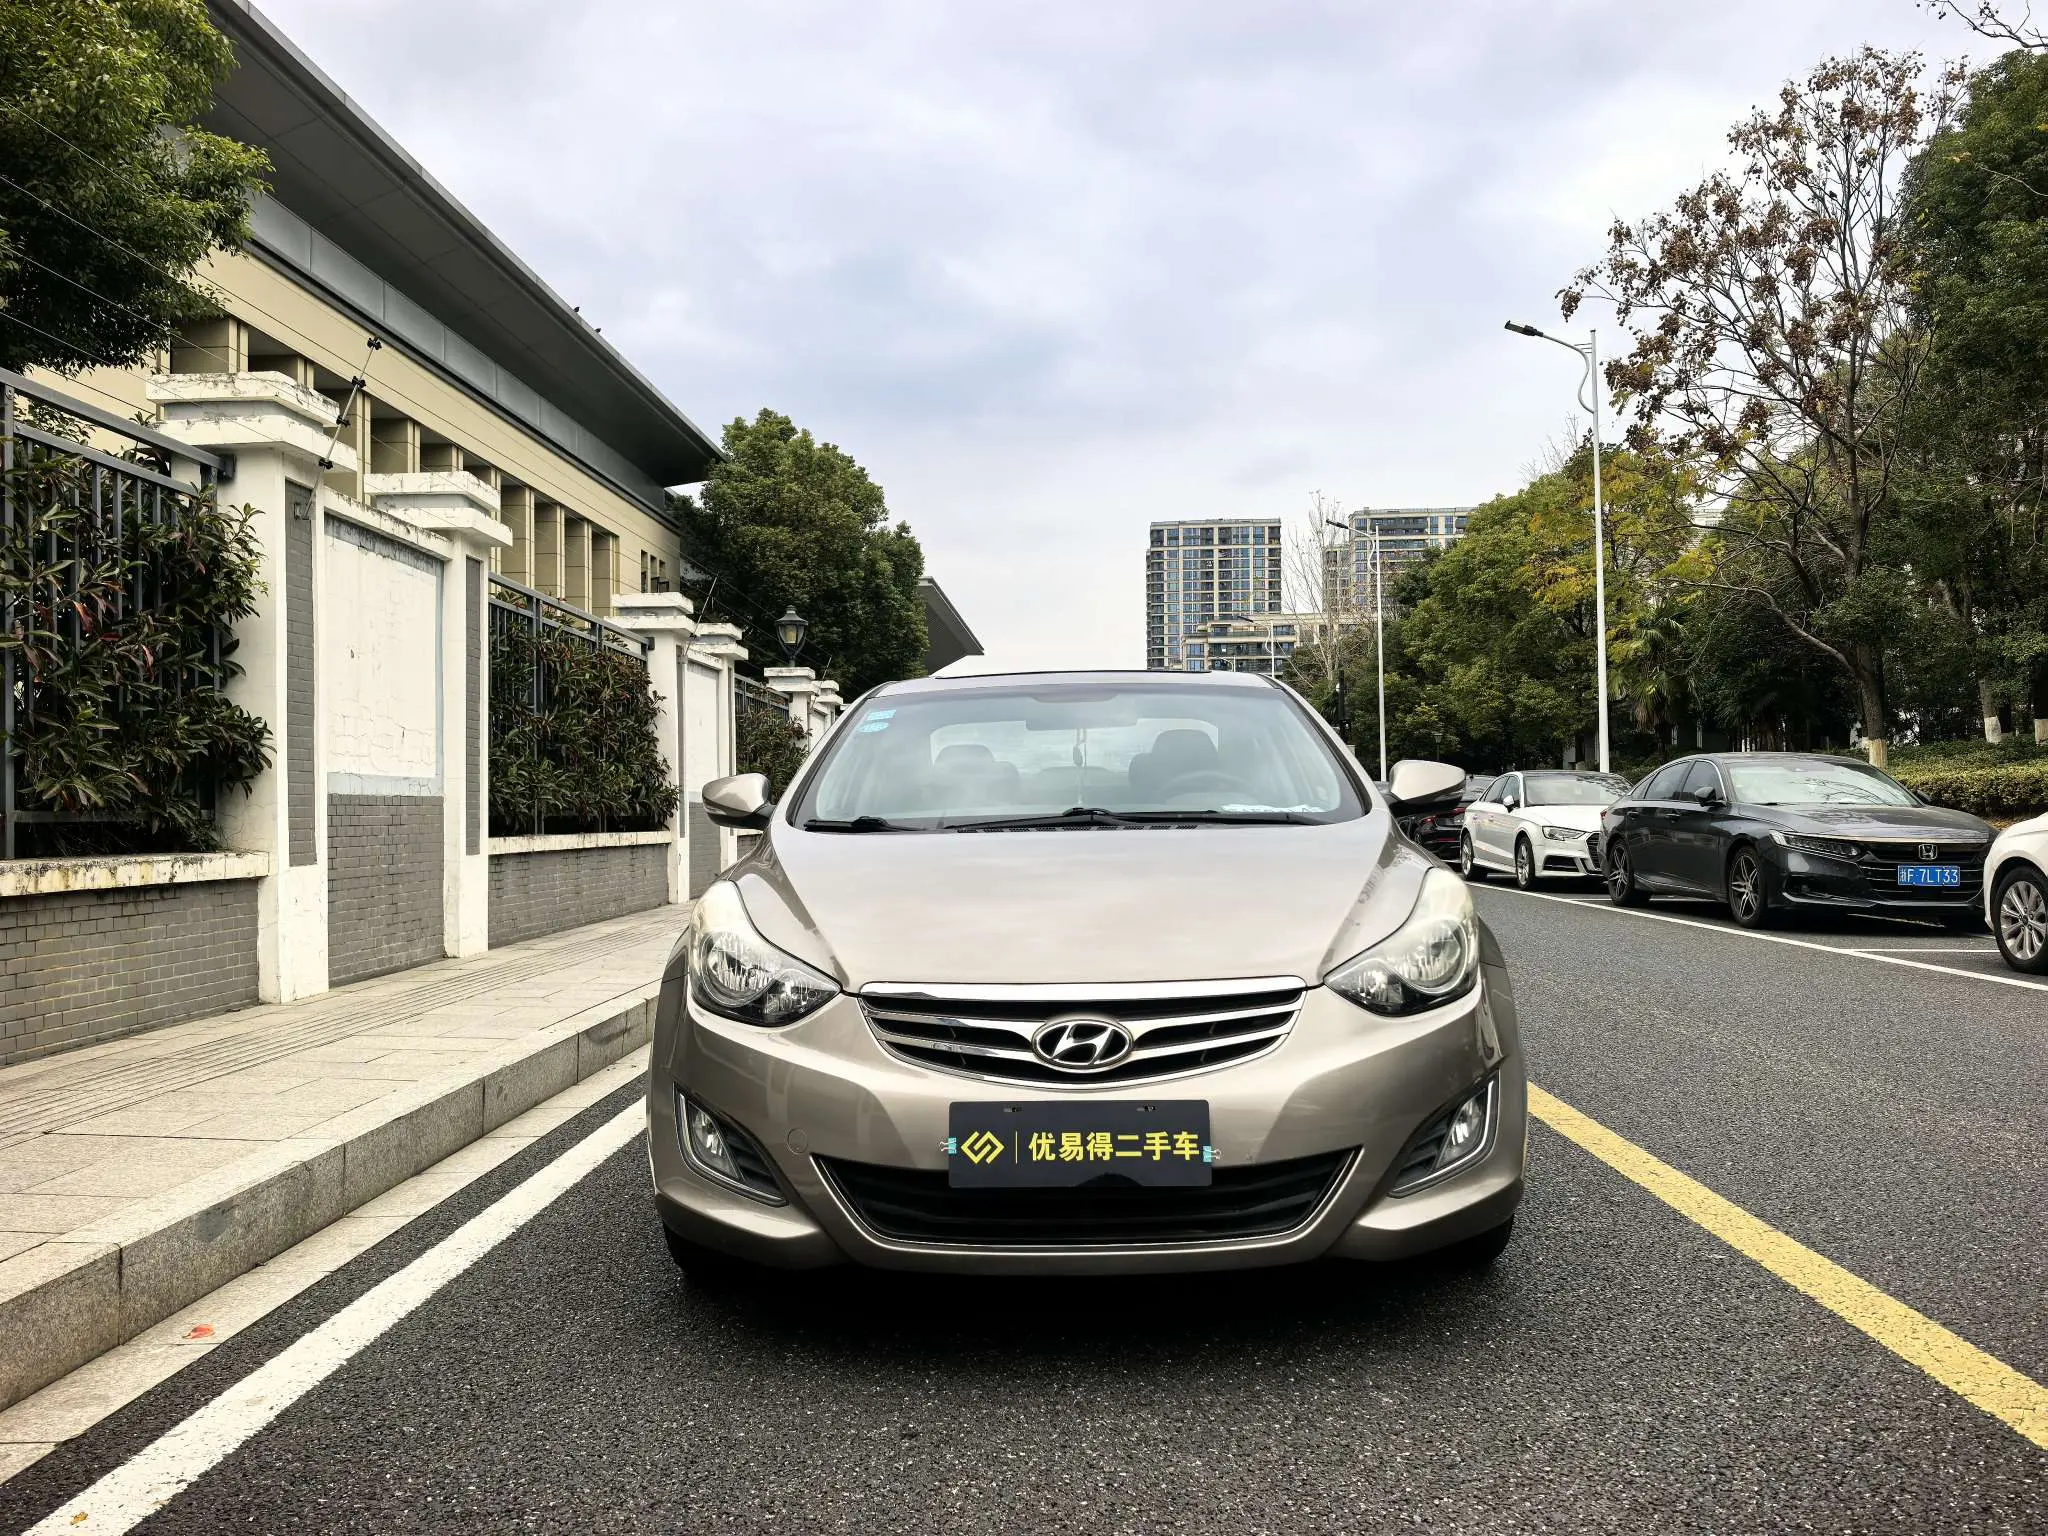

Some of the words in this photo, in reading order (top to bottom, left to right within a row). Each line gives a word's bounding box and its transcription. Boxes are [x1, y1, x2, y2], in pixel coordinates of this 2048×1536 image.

[1028, 1131, 1200, 1161] 优易得二手车
